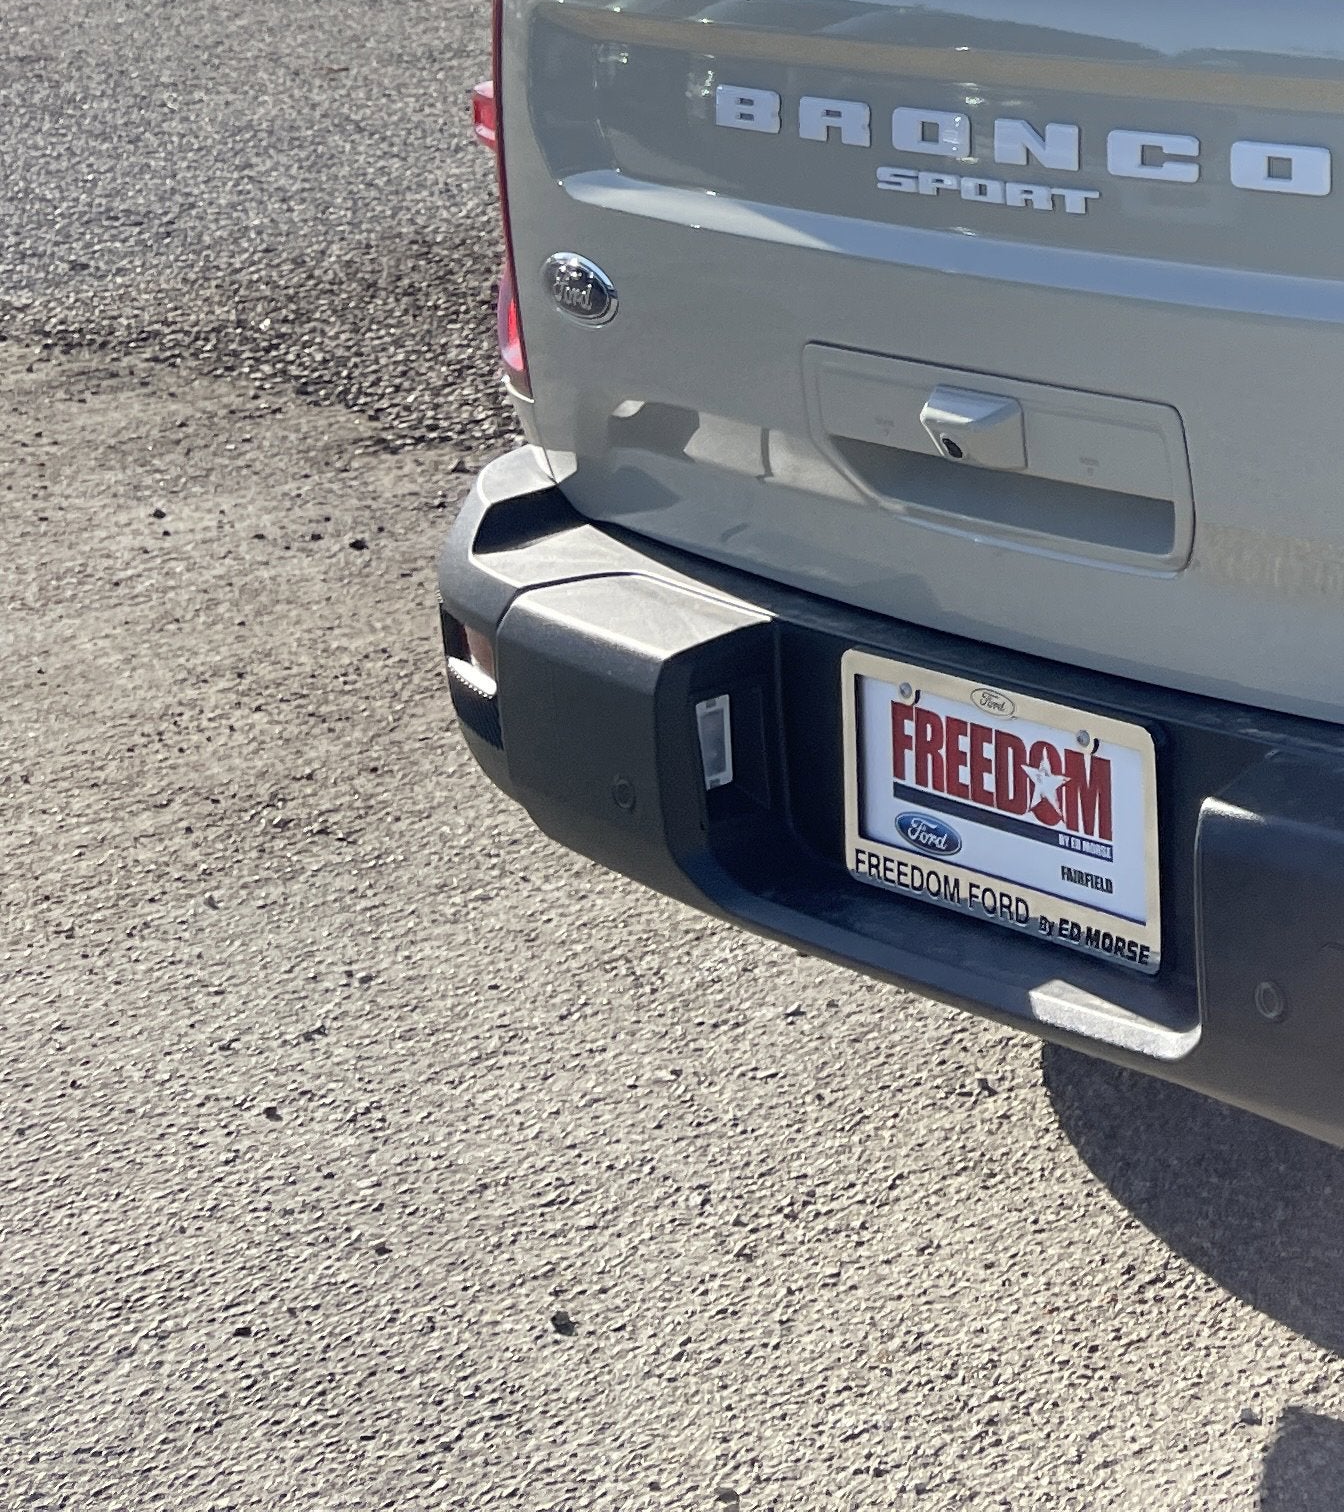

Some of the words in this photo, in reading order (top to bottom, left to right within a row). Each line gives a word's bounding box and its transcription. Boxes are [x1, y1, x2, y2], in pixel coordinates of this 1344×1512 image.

[715, 84, 1332, 196] BRONCO
[876, 166, 1099, 215] SPORT
[890, 699, 1113, 842] FREEDOM
[907, 818, 948, 850] Ford
[855, 848, 962, 906] FREEDOM
[968, 883, 1030, 925] FORD
[1059, 917, 1081, 942] ED
[1085, 926, 1150, 965] MORSE
[1061, 865, 1113, 894] FAIRFIELD
